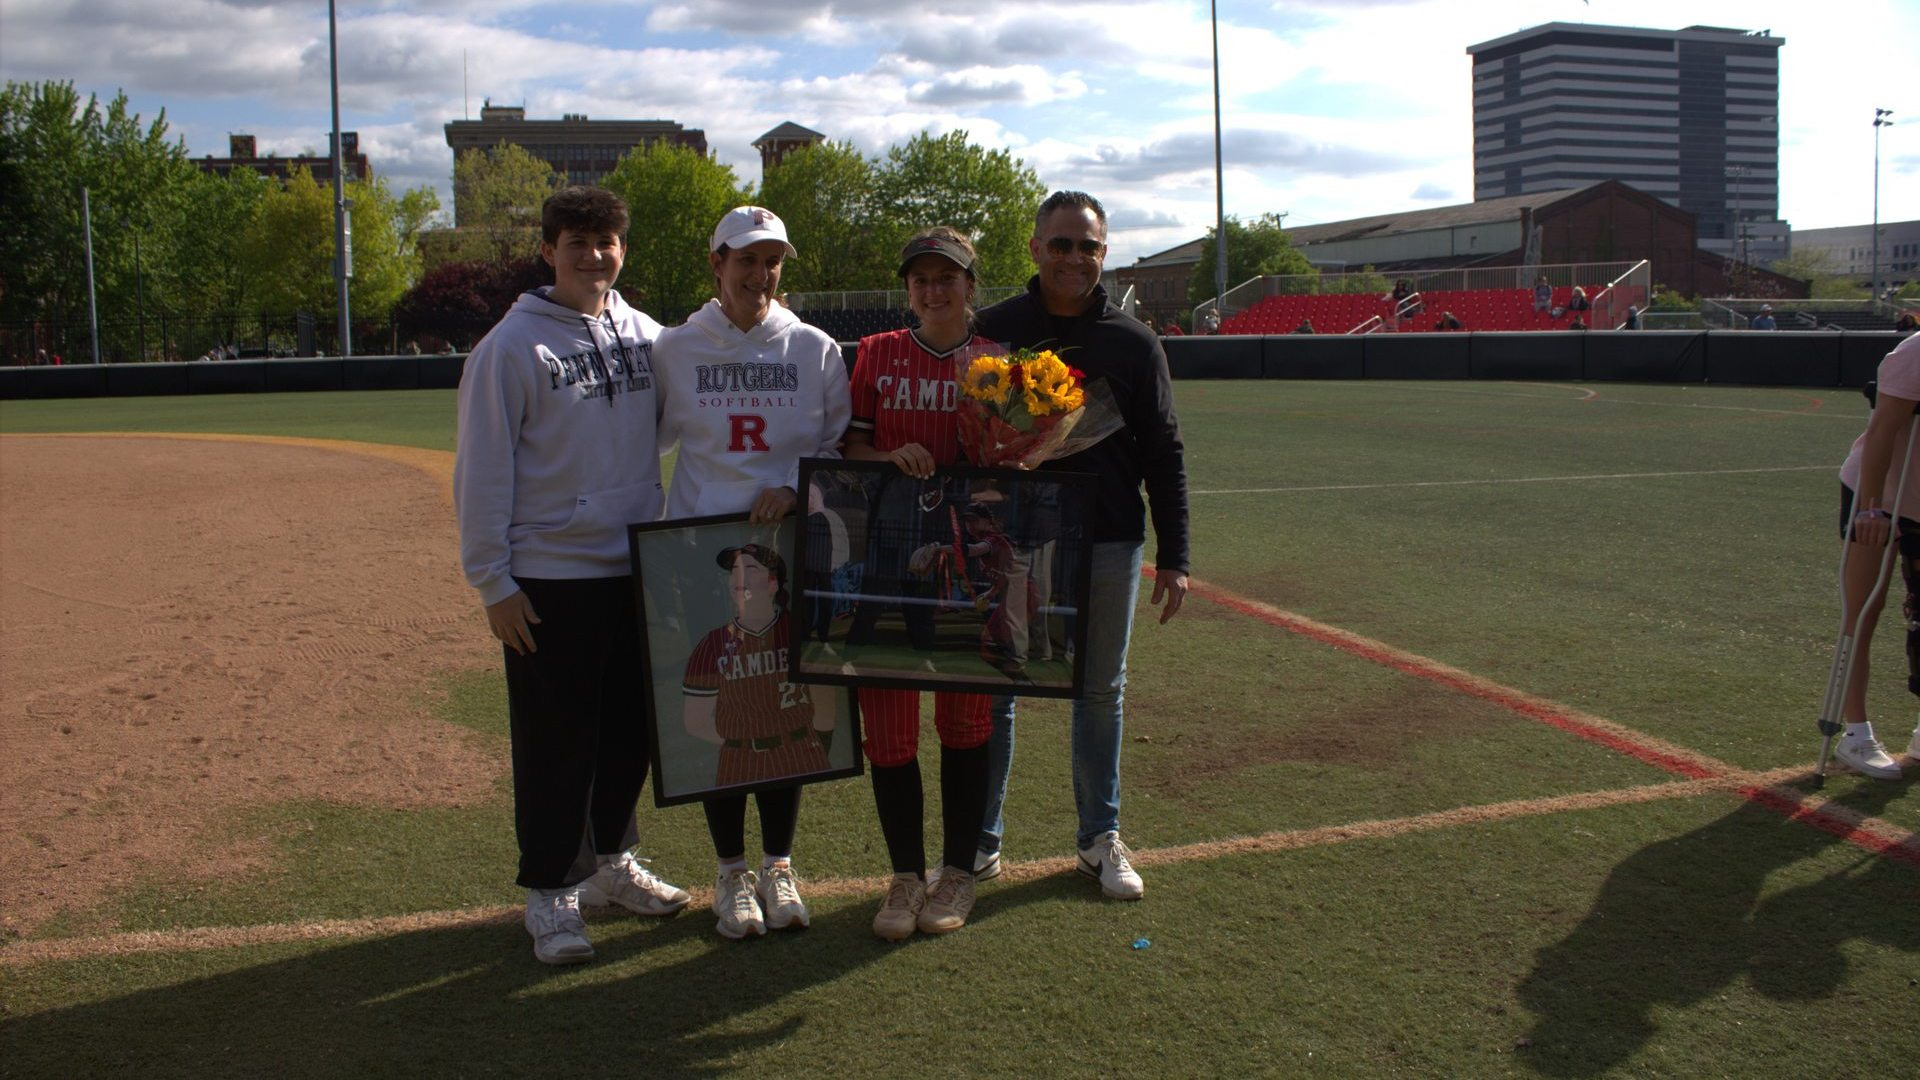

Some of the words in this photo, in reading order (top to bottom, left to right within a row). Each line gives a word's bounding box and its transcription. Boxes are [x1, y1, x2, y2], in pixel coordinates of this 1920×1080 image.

[546, 350, 605, 390] PENN
[611, 343, 653, 375] STAT
[695, 362, 799, 393] RUTGERS
[698, 397, 797, 408] SOFTBALL
[727, 413, 770, 453] R
[717, 647, 790, 681] CAMDE
